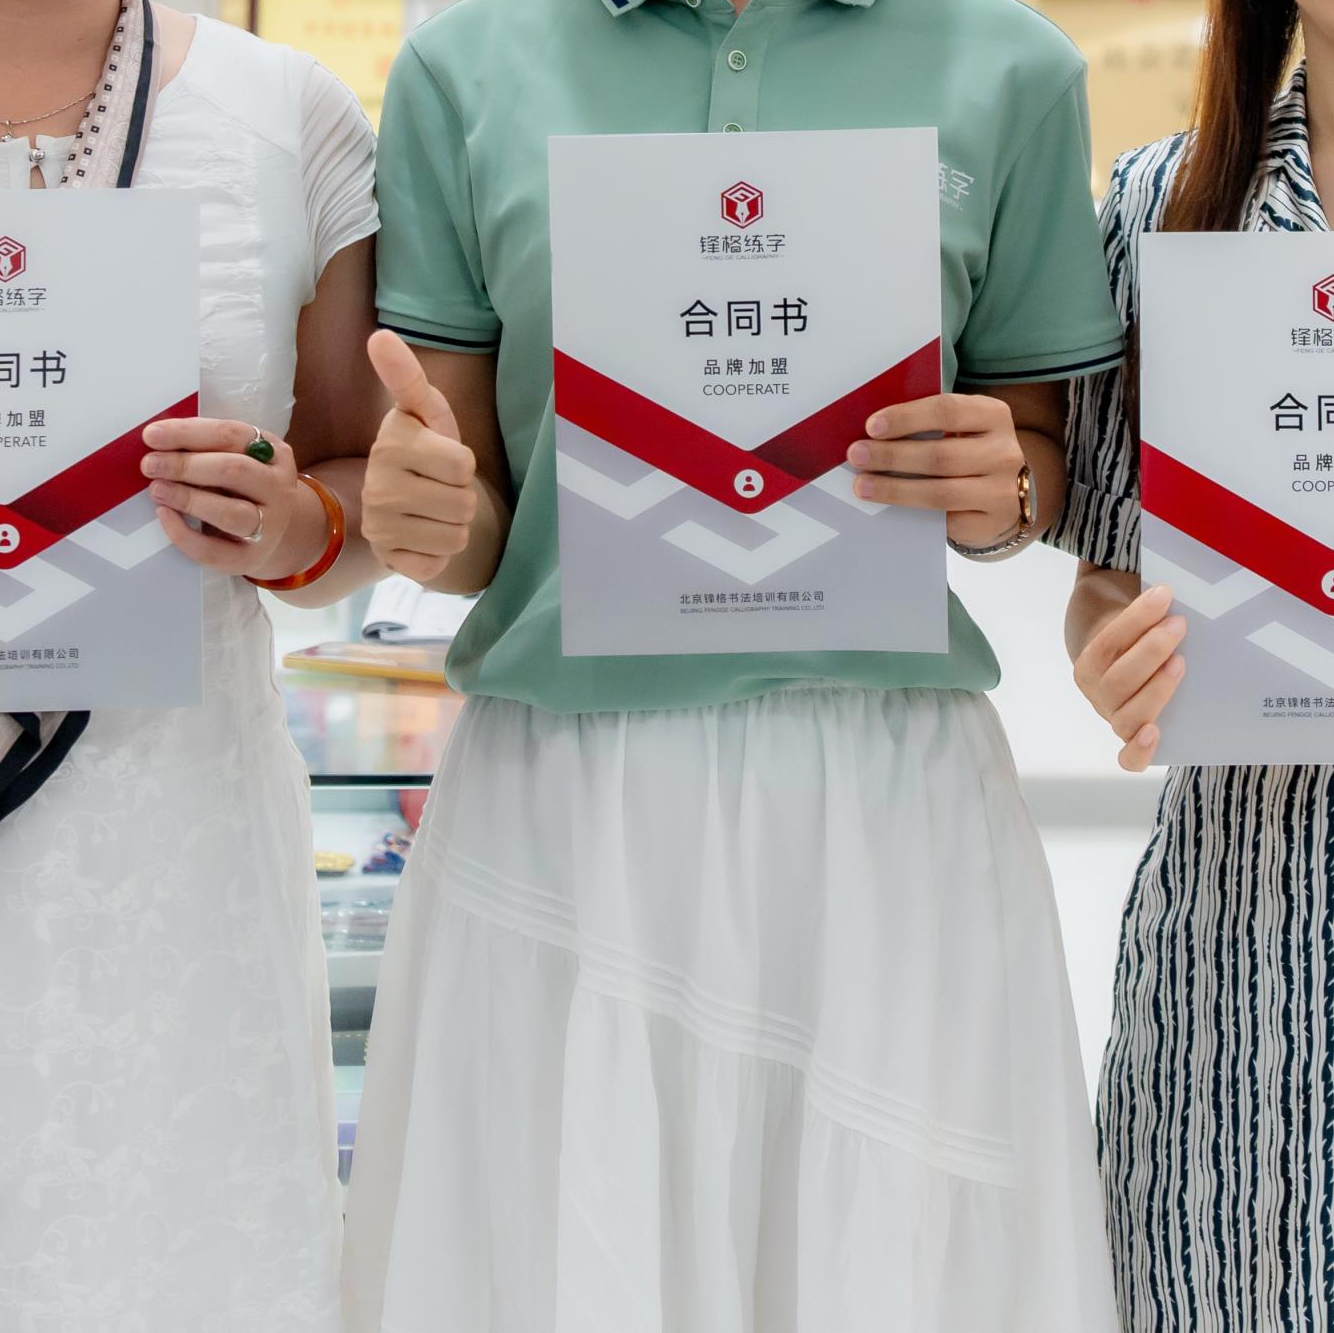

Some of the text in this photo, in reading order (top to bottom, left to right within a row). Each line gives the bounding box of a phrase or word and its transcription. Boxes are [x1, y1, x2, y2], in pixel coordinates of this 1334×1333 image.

[700, 234, 785, 253] 锋格练字
[680, 298, 808, 337] 合同书
[704, 358, 788, 376] 品牌加盟
[702, 383, 790, 395] COOPERATE
[679, 591, 824, 605] 北京锋格书法培训有限公司
